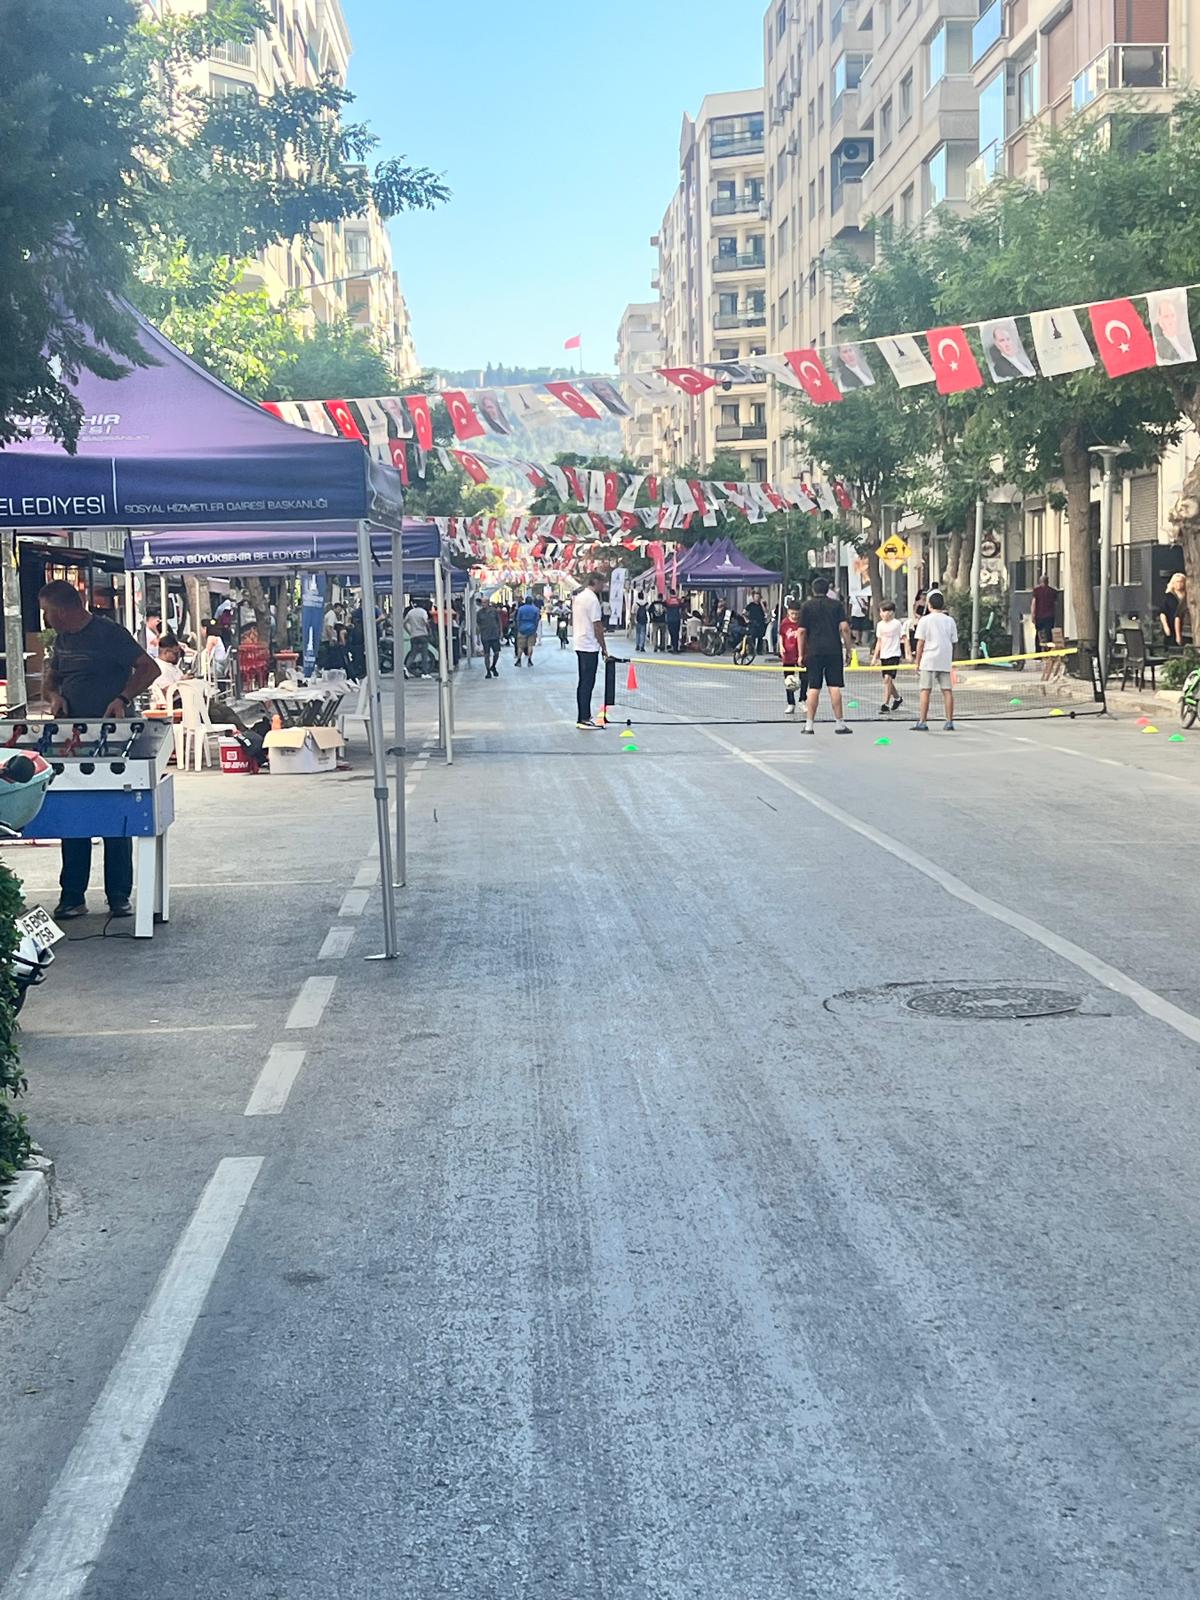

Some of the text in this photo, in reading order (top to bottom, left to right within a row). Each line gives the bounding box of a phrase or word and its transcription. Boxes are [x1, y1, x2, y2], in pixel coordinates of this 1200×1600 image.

[124, 503, 165, 514] SOSYAL
[155, 555, 185, 565] İZMİR
[253, 549, 311, 561] BELEDİYESİ
